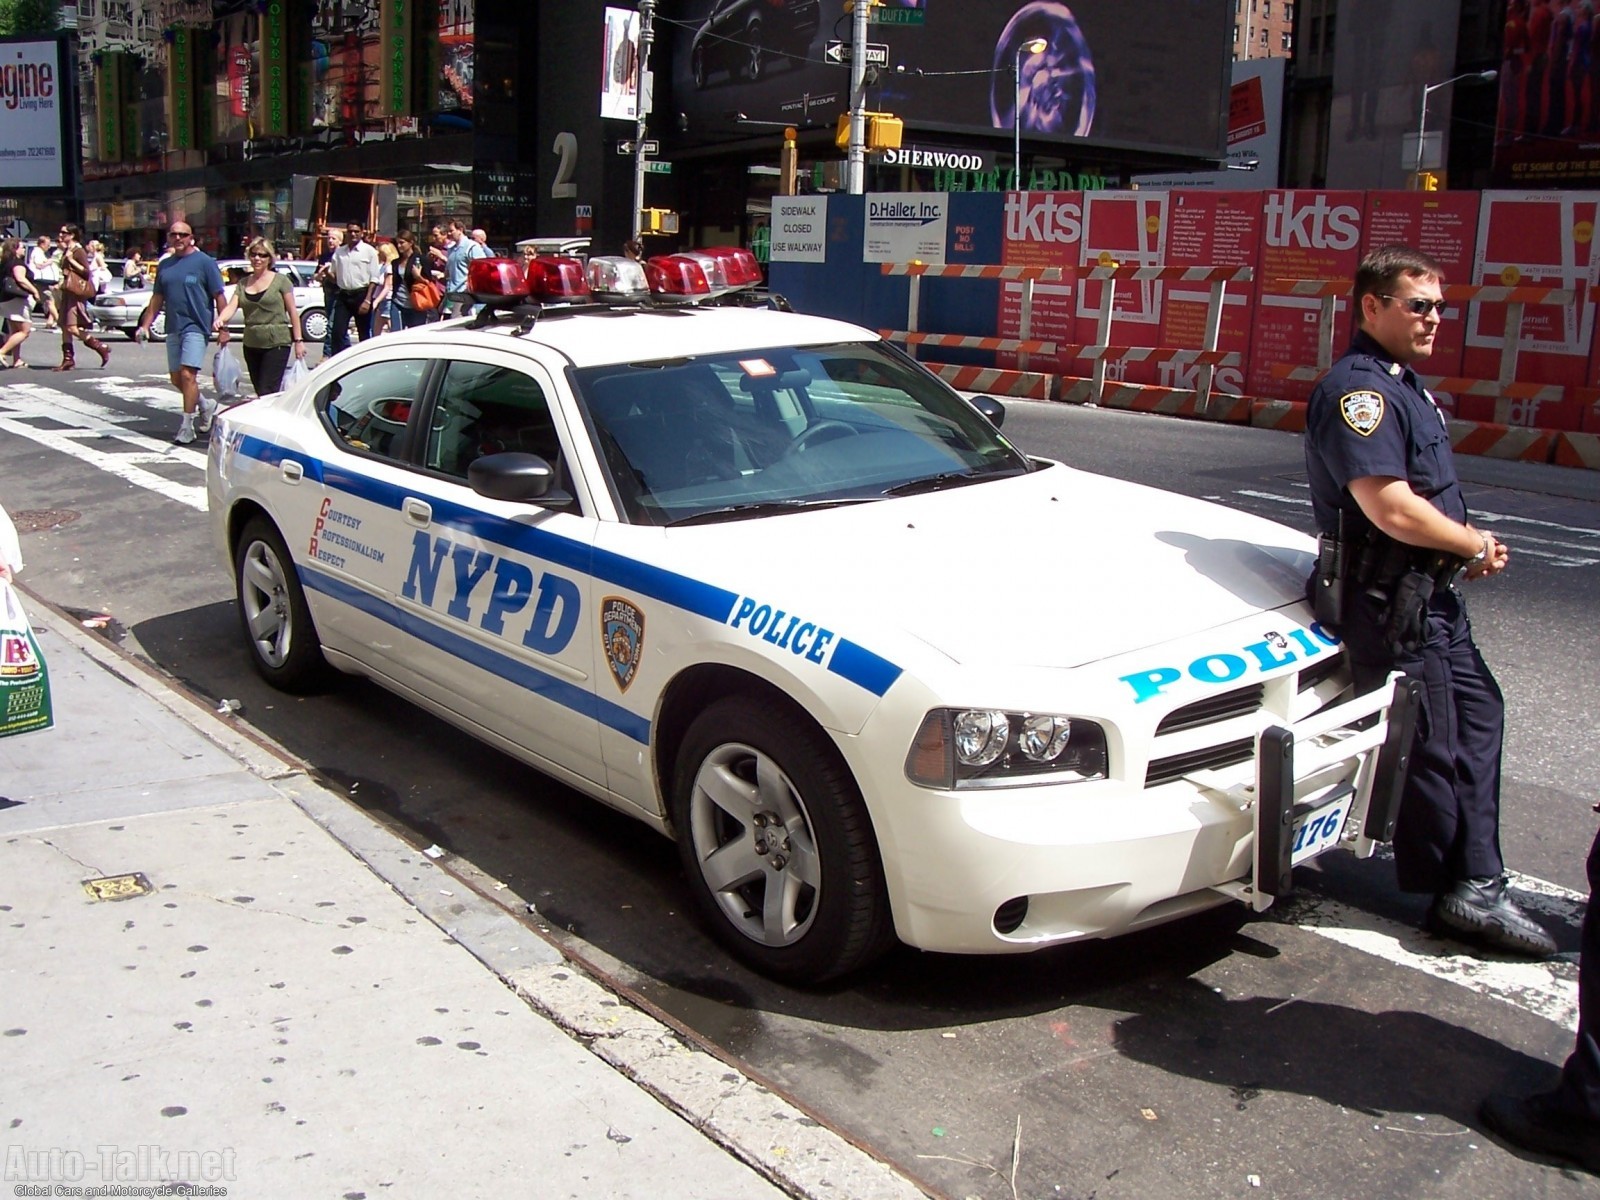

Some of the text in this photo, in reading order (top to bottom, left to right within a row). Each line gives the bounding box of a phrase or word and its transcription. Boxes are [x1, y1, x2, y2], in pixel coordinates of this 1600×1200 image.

[881, 9, 911, 21] DUFFY
[270, 3, 281, 131] OLIVE GARDEN
[0, 51, 53, 110] gine
[20, 98, 54, 111] Living Here
[782, 103, 804, 111] PONTIAC
[817, 97, 836, 105] COUPE
[551, 131, 578, 199] 2
[883, 148, 983, 171] SHERWOOD
[1511, 162, 1528, 172] GET
[1530, 162, 1555, 171] SOME
[1556, 161, 1568, 171] OF
[1571, 160, 1587, 170] THE
[781, 206, 816, 216] SIDEWALK
[869, 201, 942, 219] D.Haller, Inc.
[1004, 191, 1082, 244] tkts
[1263, 190, 1361, 251] tkts
[783, 223, 812, 233] CLOSED
[955, 226, 975, 234] POST
[959, 234, 971, 242] NO
[772, 242, 823, 252] USE WALKWAY
[954, 243, 974, 251] BILLS
[1157, 359, 1244, 396] tks
[320, 497, 362, 530] COURTESY
[313, 517, 385, 563] PROFESSIONALISM
[308, 537, 346, 569] RESPECT
[402, 530, 582, 655] NYPD
[612, 601, 636, 619] POLICE
[603, 610, 642, 637] DEPARTMENT
[730, 596, 835, 665] POLICE
[603, 633, 618, 673] CITY OF
[624, 643, 641, 682] NEW YORK
[8, 695, 42, 706] SERVICE
[9, 688, 44, 700] QUALITY
